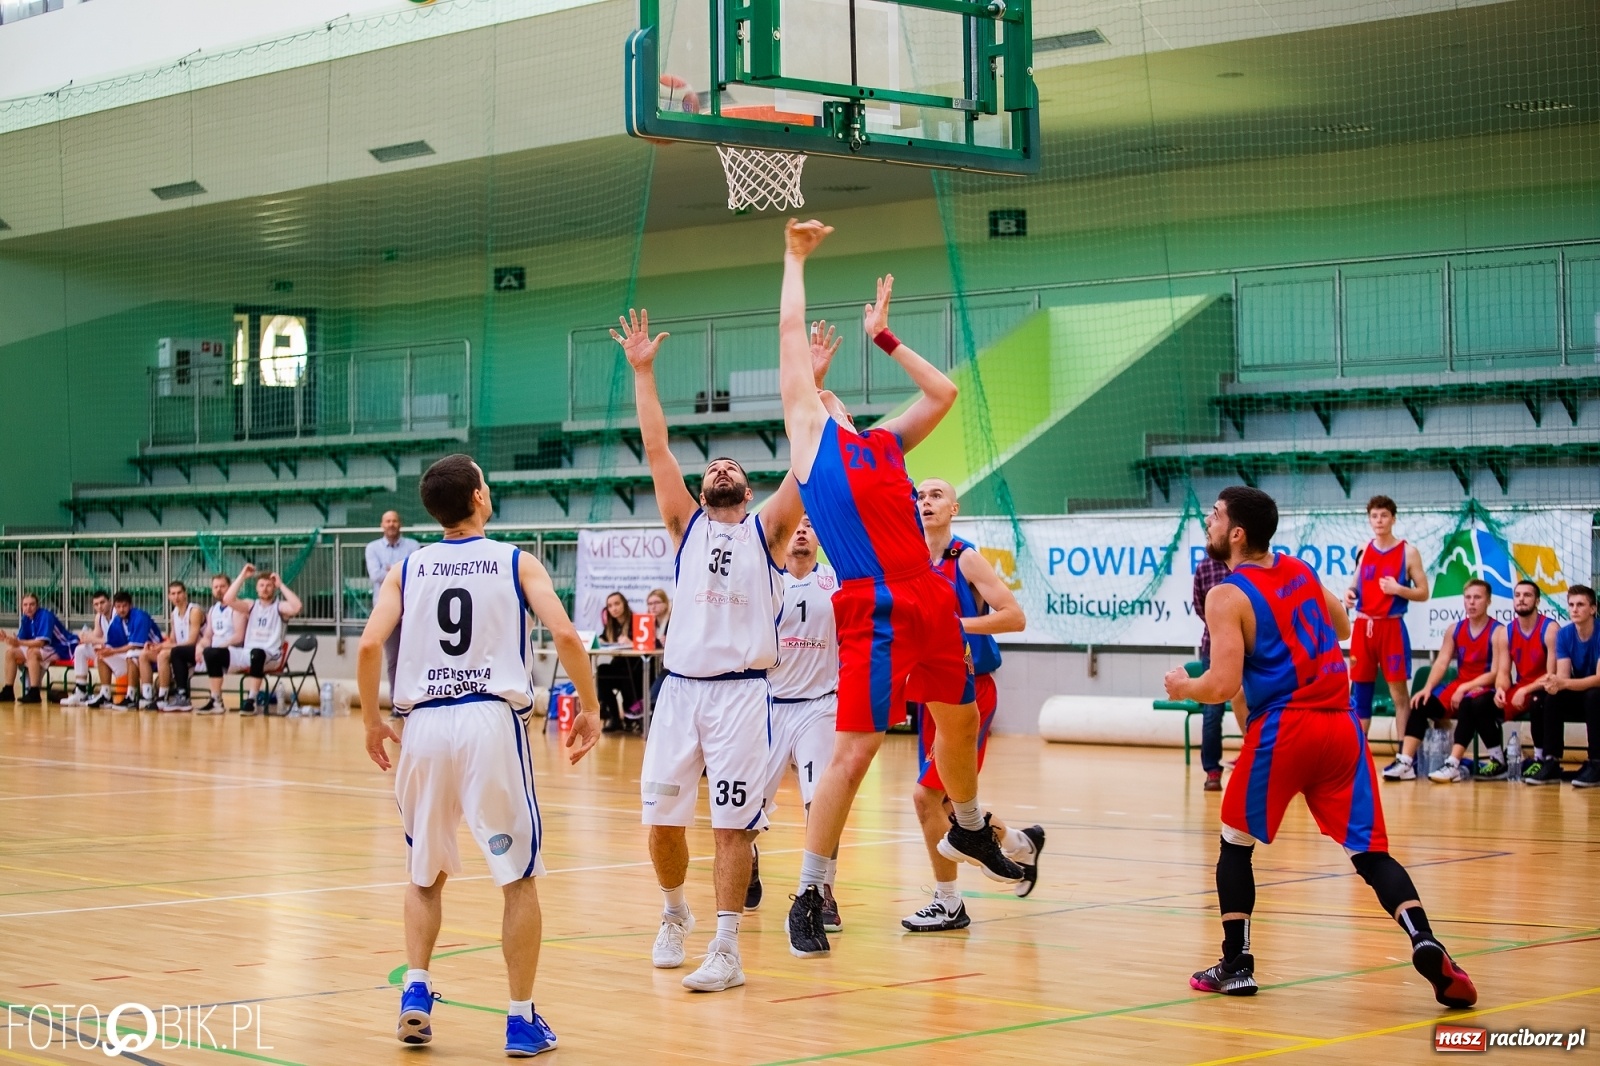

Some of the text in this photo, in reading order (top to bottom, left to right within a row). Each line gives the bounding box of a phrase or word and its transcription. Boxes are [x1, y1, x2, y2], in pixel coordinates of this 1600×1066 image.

[998, 219, 1017, 233] B
[500, 275, 519, 288] A
[846, 443, 877, 470] 24
[588, 536, 667, 558] MIESZKO
[417, 560, 498, 577] A. ZWIERZYNA
[708, 548, 732, 576] 35
[1048, 546, 1178, 576] POWIAT
[796, 600, 807, 622] 1
[1047, 594, 1171, 620] kibicujemy,
[437, 588, 473, 656] 9
[636, 616, 650, 643] 5
[1291, 598, 1337, 660] 18
[427, 667, 491, 682] OFENSYWA
[560, 698, 571, 723] 5
[804, 760, 813, 783] 1
[715, 780, 747, 807] 35
